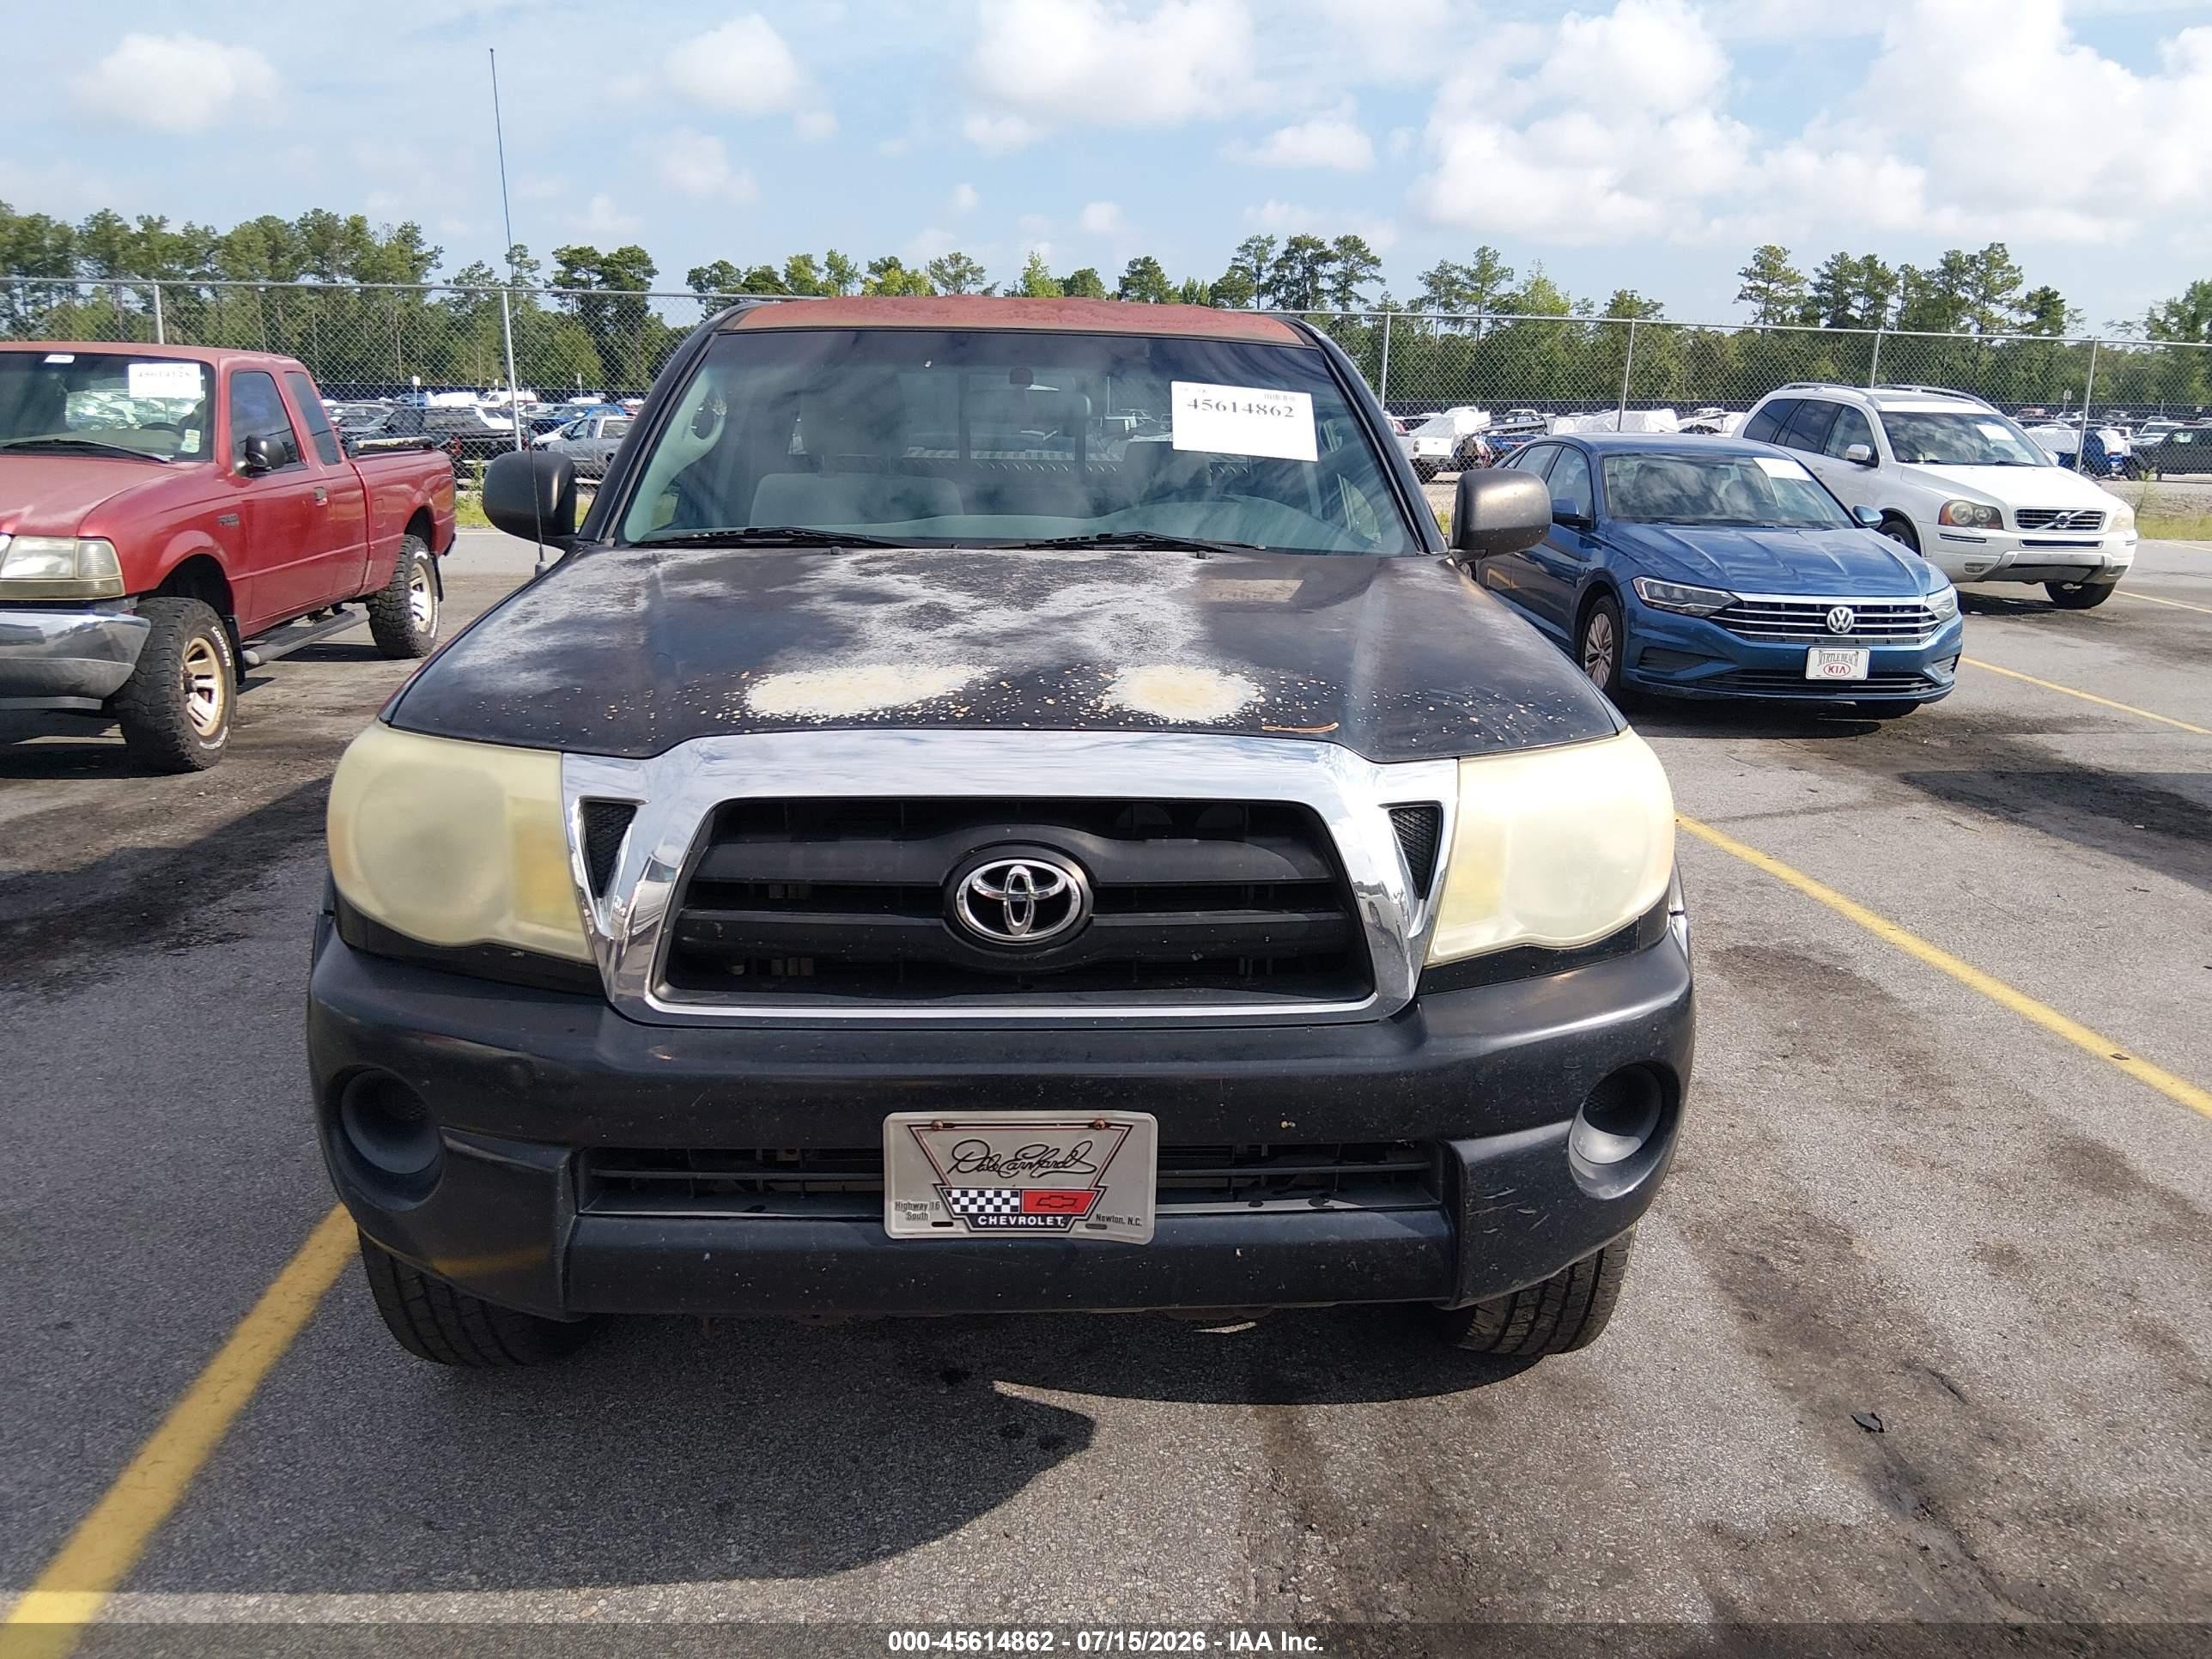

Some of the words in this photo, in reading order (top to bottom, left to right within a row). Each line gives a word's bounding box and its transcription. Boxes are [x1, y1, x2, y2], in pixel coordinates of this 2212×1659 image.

[1187, 398, 1295, 417] 45614862
[1828, 665, 1846, 674] KIA
[947, 1139, 1006, 1174] Dale
[894, 1201, 927, 1212] Highway
[906, 1211, 928, 1220] South
[977, 1215, 1064, 1226] CHEVROLET
[1127, 1216, 1143, 1227] N.C.
